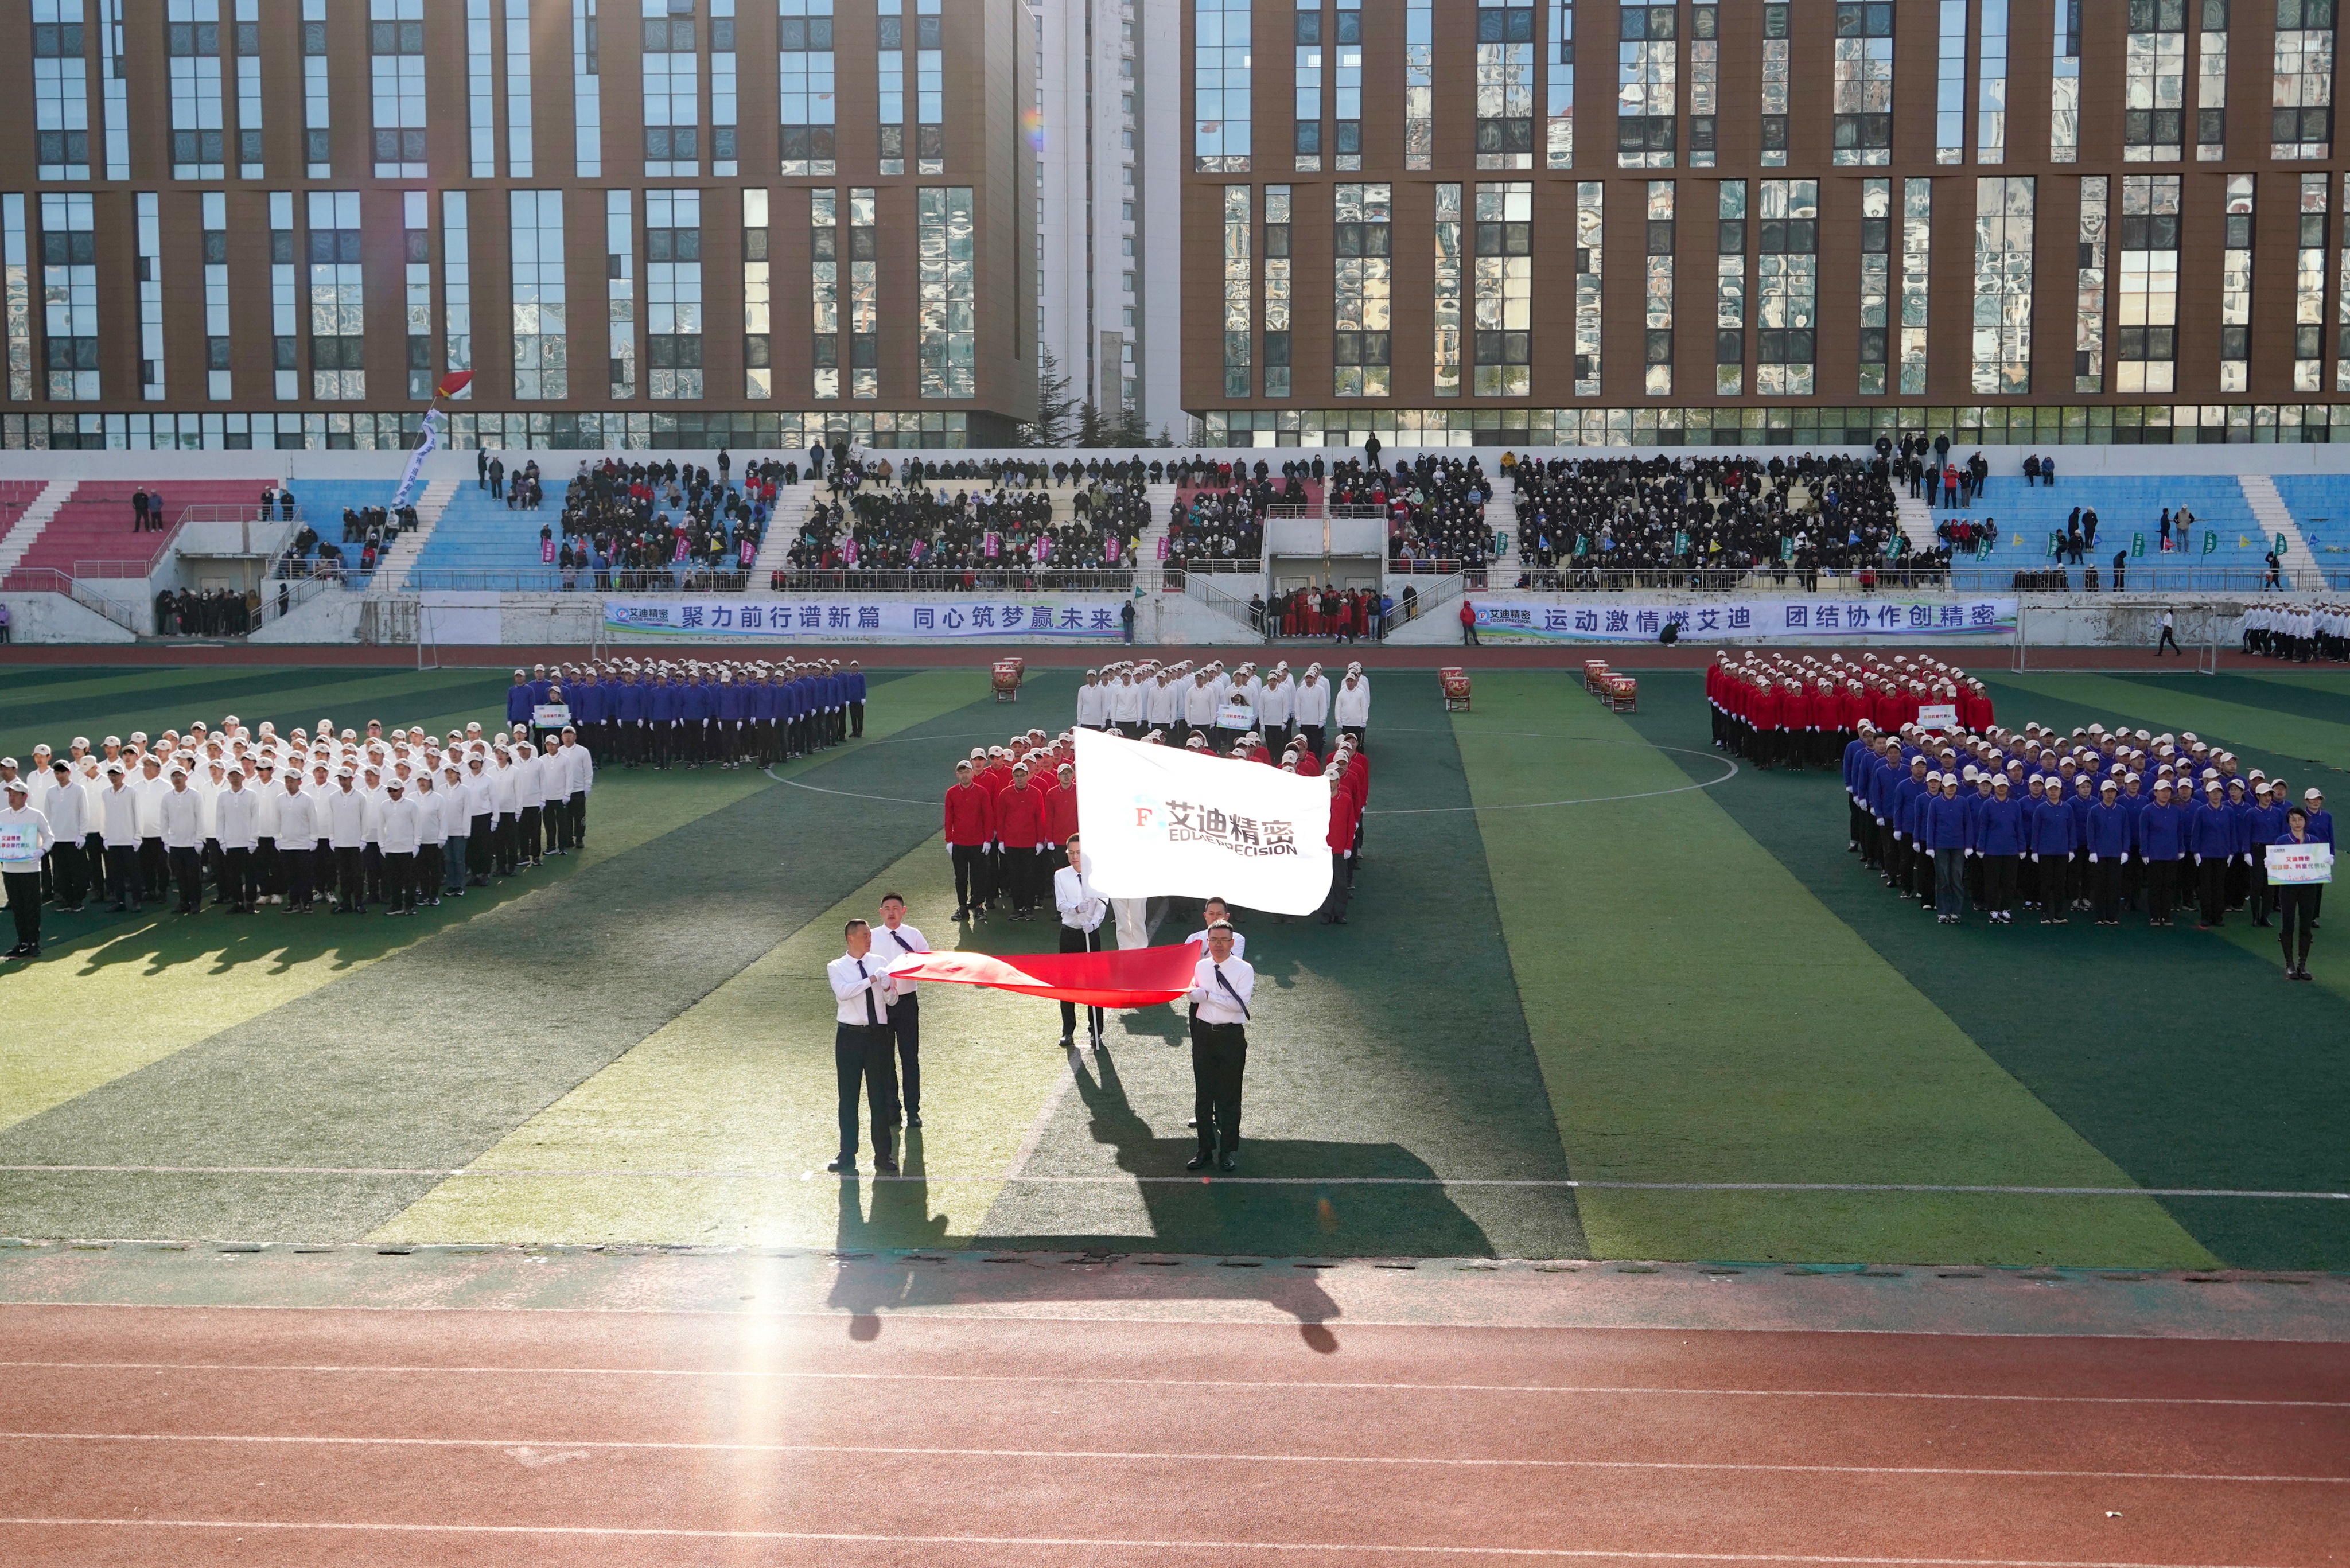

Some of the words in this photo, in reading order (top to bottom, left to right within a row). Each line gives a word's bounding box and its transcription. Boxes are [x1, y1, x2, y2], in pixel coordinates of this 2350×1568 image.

[629, 608, 668, 618] 艾迪精密
[682, 605, 880, 628] 聚力前行谱新篇
[913, 605, 1115, 630] 同心筑梦赢未来
[1490, 610, 1531, 620] 艾迪精密
[1544, 606, 1750, 632] 运动激情燃艾迪
[1786, 605, 1994, 627] 团结协作创精密
[1135, 808, 1152, 826] F
[1165, 800, 1295, 846] 艾迪精密
